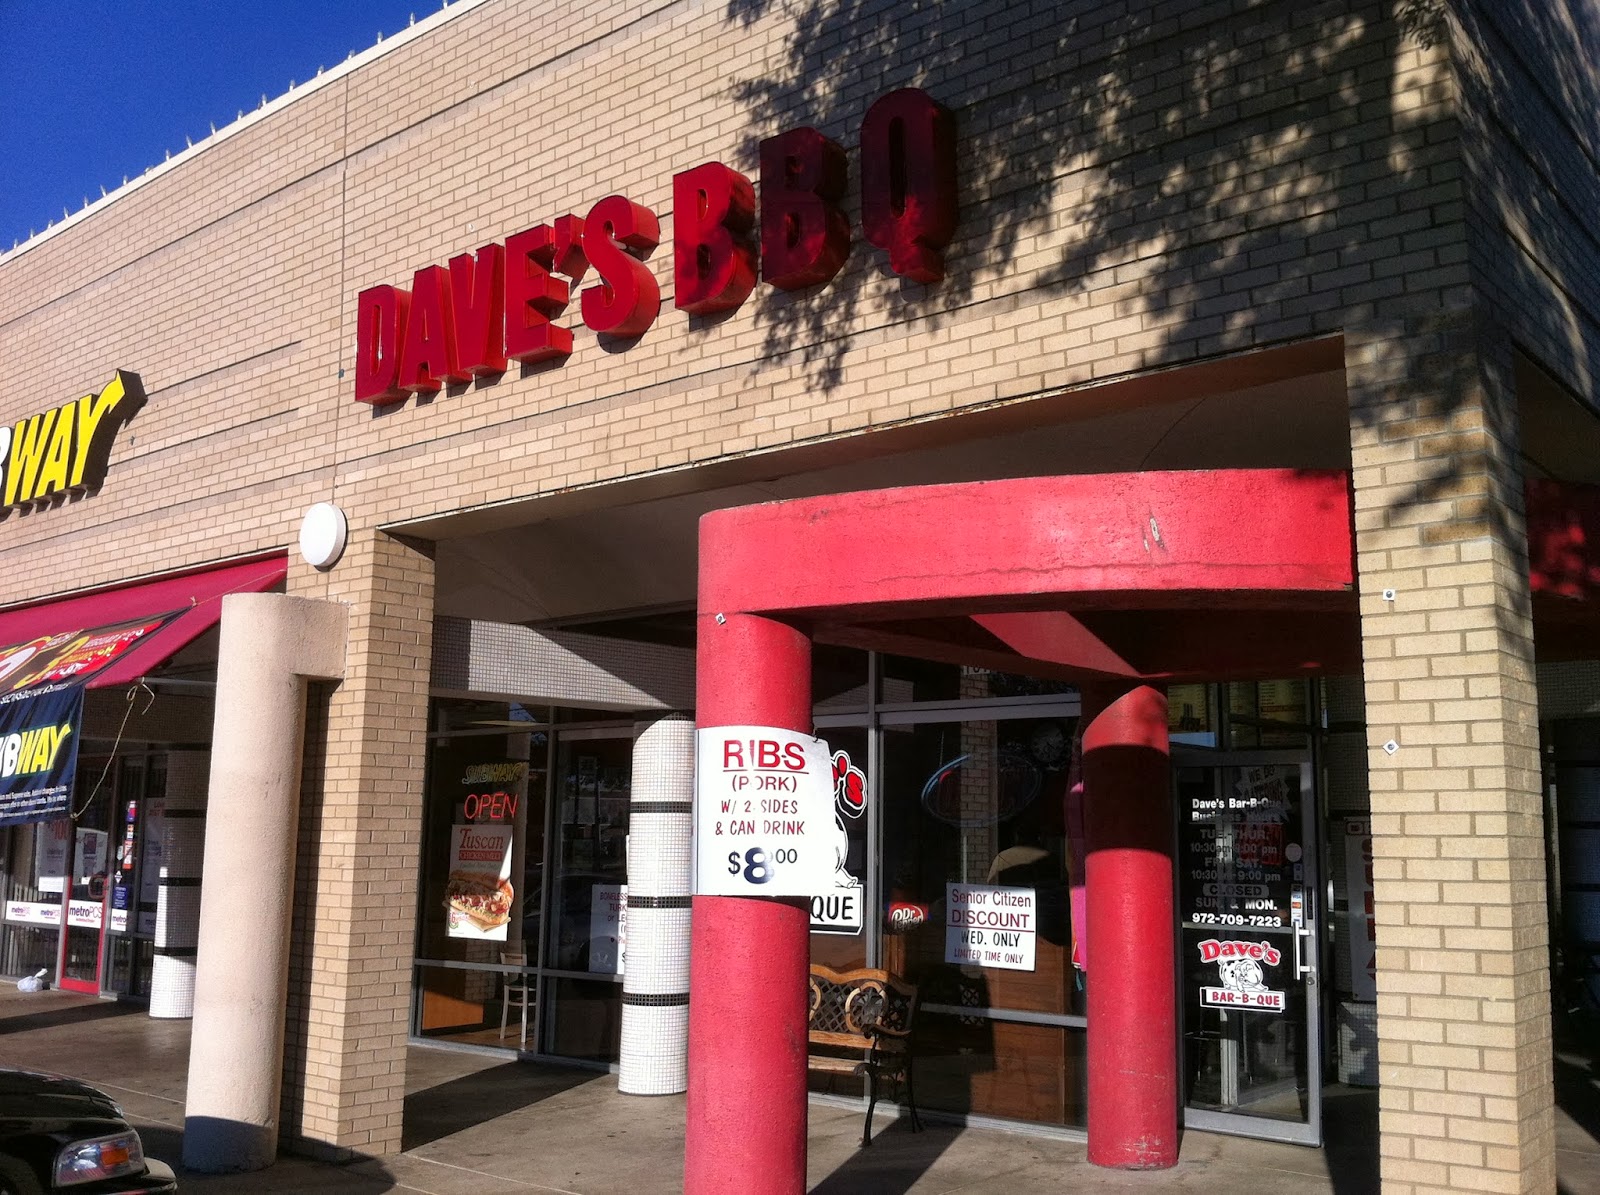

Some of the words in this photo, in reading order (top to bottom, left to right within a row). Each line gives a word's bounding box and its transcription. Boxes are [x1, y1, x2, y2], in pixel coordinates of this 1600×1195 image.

[355, 195, 660, 404] DAVE'S
[723, 739, 805, 770] RIBS
[731, 774, 797, 793] (PORK)
[464, 792, 518, 819] OPEN
[761, 800, 798, 814] SIDES
[1192, 798, 1225, 809] Dave's
[715, 821, 723, 835] &
[730, 820, 755, 835] CAN
[763, 821, 805, 835] DRINK
[460, 829, 504, 850] Tuscan
[952, 889, 987, 904] Senior
[992, 891, 1031, 907] Citizen
[1209, 885, 1262, 896] CLOSED
[69, 905, 102, 919] metroPCS
[1245, 899, 1278, 910] MON.
[952, 909, 1029, 928] DISCOUNT
[1192, 913, 1281, 927] 972-709-7223
[961, 930, 987, 946] WED.
[993, 932, 1021, 947] ONLY
[954, 949, 981, 960] LIMITED
[985, 951, 1001, 961] TIME
[1004, 954, 1023, 964] ONLY
[1200, 940, 1280, 965] Dave's
[1212, 991, 1280, 1006] BAR-B-QUE
